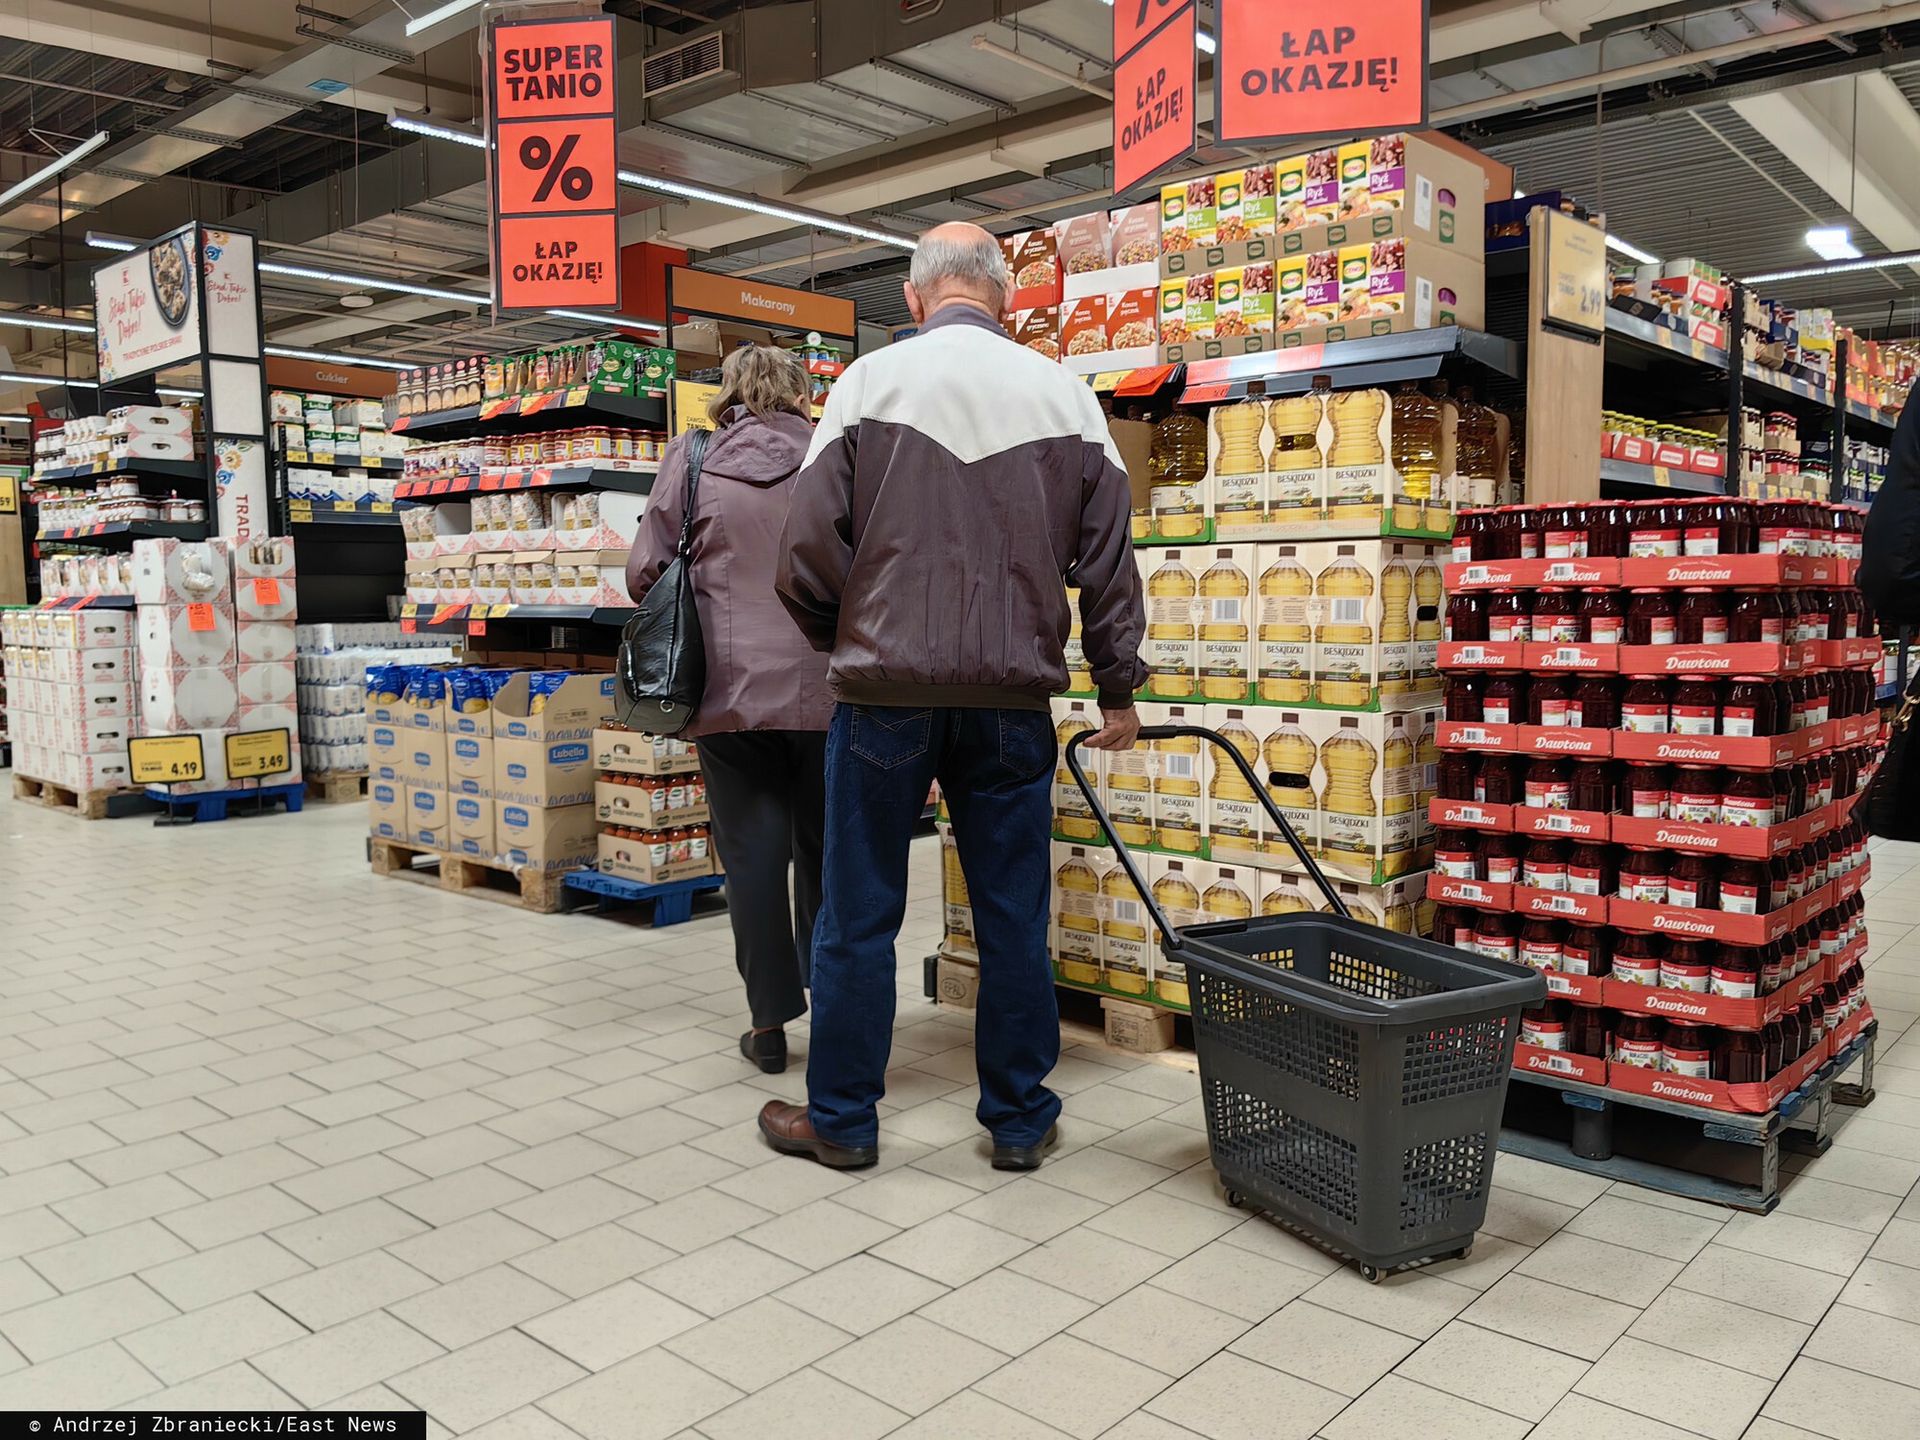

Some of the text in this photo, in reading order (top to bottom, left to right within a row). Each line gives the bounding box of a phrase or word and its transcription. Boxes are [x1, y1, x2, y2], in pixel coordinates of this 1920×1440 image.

[1280, 26, 1356, 60] ŁAP
[504, 44, 603, 74] SUPER
[1240, 57, 1398, 96] OKAZJĘ!
[506, 72, 602, 101] TANIO
[1136, 67, 1166, 110] ŁAP
[1121, 86, 1183, 152] OKAZJĘ!
[519, 134, 593, 202] %
[1372, 172, 1389, 186] Ryż
[1307, 185, 1324, 200] Ryż
[535, 241, 578, 259] ŁAP
[513, 262, 603, 284] OKAZJĘ!
[1372, 275, 1389, 288] Ryż
[1307, 286, 1324, 300] Ryż
[741, 291, 796, 316] Makarony
[316, 371, 349, 384] Cukier
[1277, 472, 1316, 484] BESKIDZKI
[1336, 468, 1377, 480] BESKIDZKI
[1222, 476, 1258, 488] BESKIDZKI
[1667, 568, 1732, 581] Dawtona
[1155, 643, 1189, 652] BESKIDZKI
[1206, 644, 1242, 654] BESKIDZKI
[1266, 644, 1304, 655] BESKIDZKI
[1323, 646, 1364, 657] BESKIDZKI
[1665, 656, 1730, 670] Dawtona
[1535, 736, 1592, 750] Dawtona
[553, 748, 586, 758] Lubella
[1656, 745, 1720, 760] Dawtona
[171, 762, 197, 776] 4.19
[259, 755, 283, 769] 3.49
[1216, 802, 1252, 814] BESKIDZKI
[1328, 816, 1369, 829] BESKIDZKI
[1655, 830, 1719, 848] Dawtona
[1653, 915, 1715, 934] Dawtona
[1646, 996, 1707, 1016] Dawtona
[1652, 1081, 1714, 1102] Dawtona
